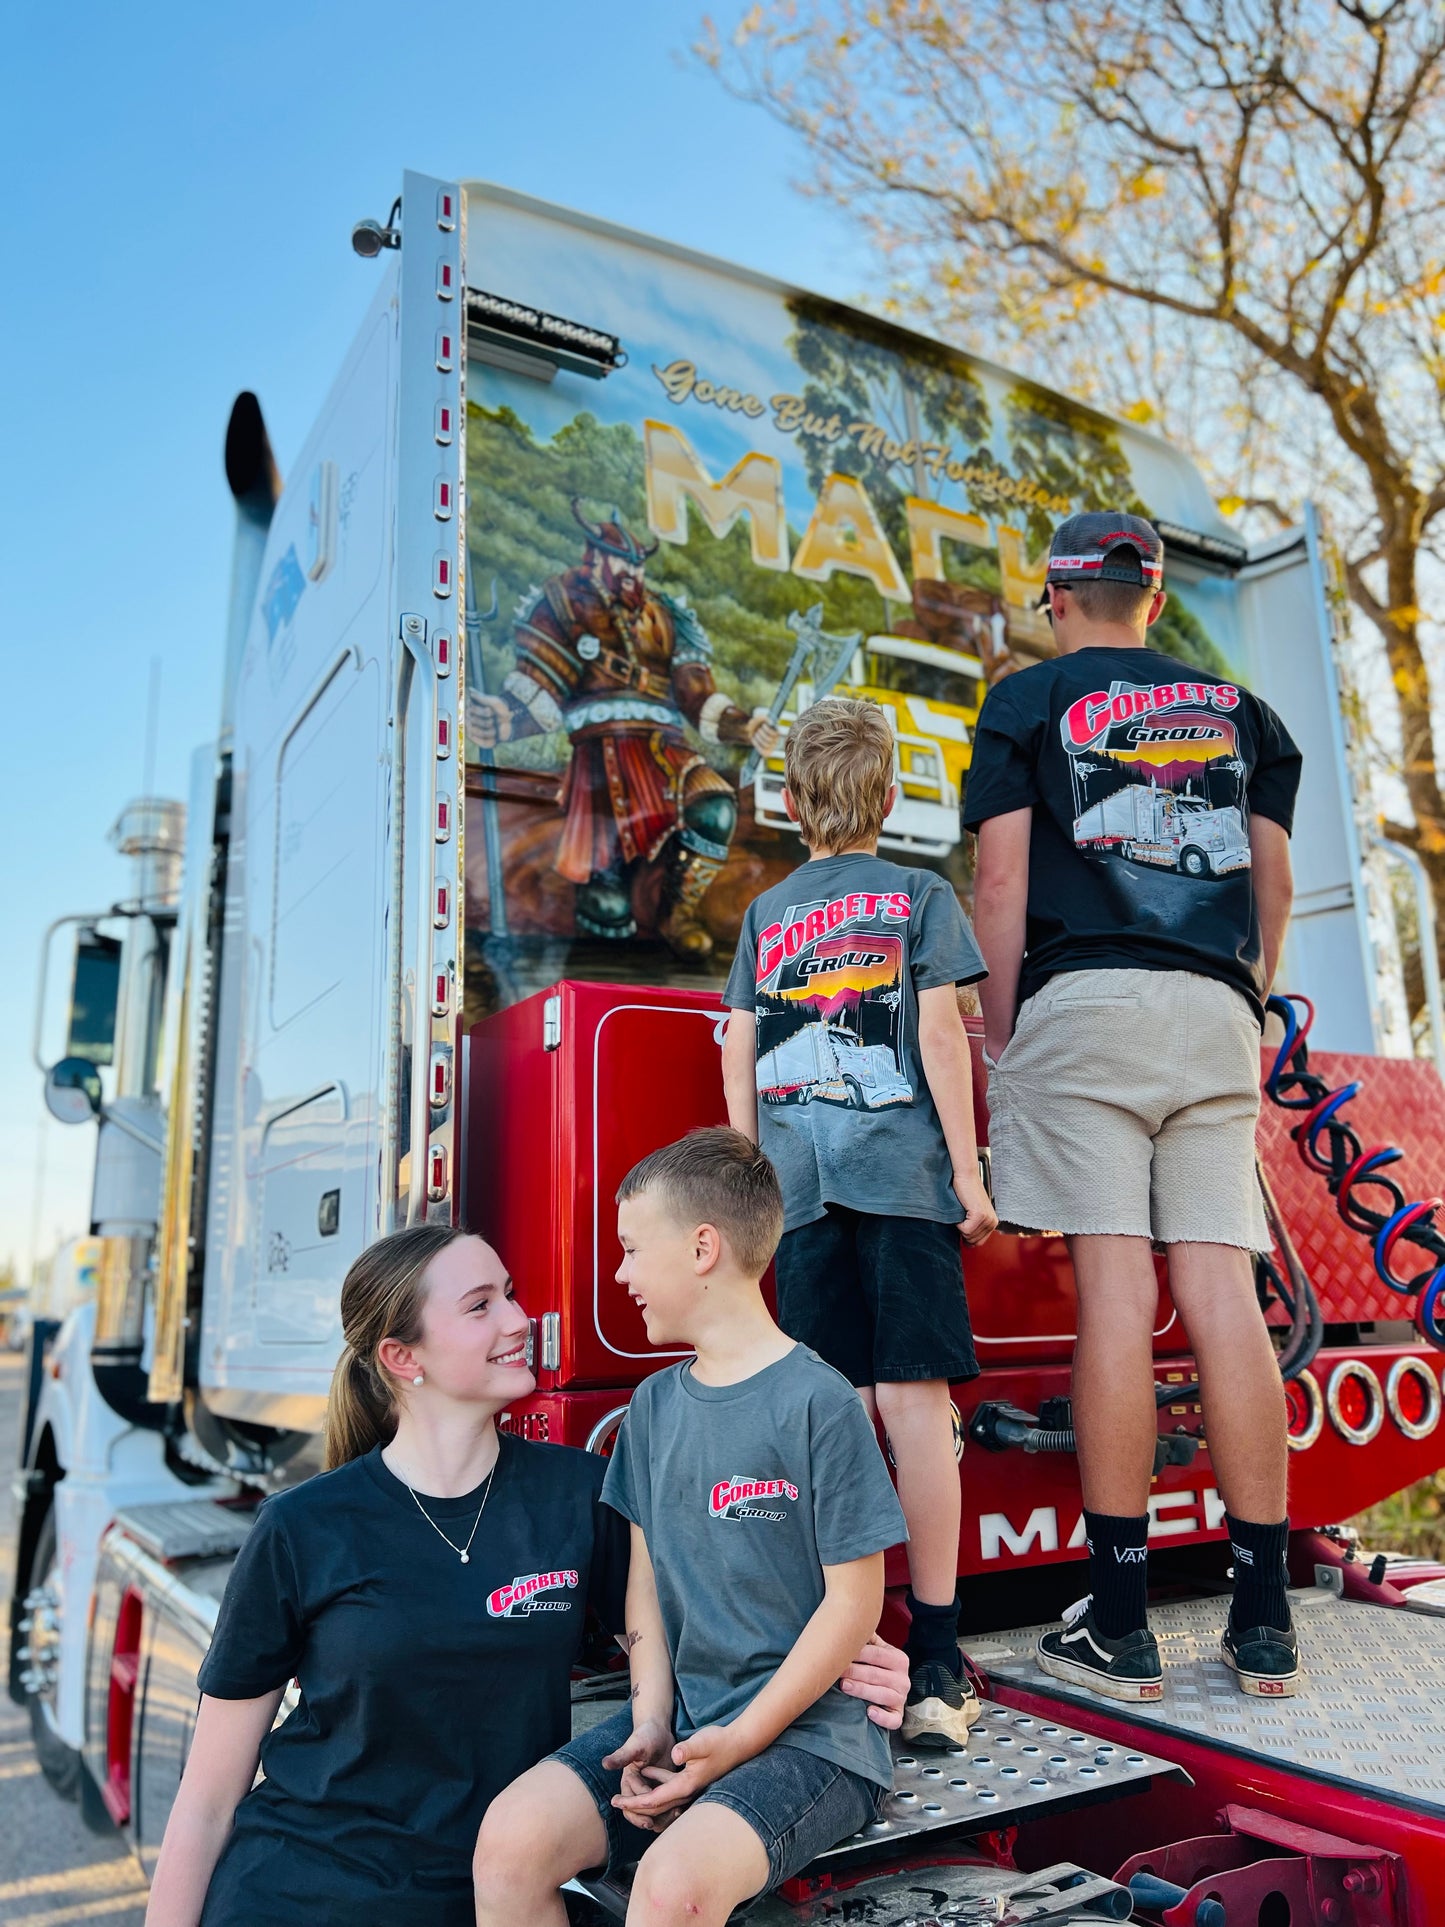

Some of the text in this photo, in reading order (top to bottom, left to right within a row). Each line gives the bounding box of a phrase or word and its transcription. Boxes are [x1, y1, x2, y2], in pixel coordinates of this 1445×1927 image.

[652, 360, 1072, 515] Gone But Not Forgotten
[567, 700, 674, 730] VOLVO
[1061, 682, 1240, 752] CORBET'S
[1127, 726, 1224, 742] GROUP
[755, 893, 911, 988] CORBET'S
[797, 950, 888, 977] GROUP
[709, 1479, 799, 1514] CORBET'S
[736, 1506, 787, 1521] GROUP
[979, 1487, 1227, 1561] MC
[1113, 1545, 1148, 1564] VAN
[487, 1570, 579, 1616] CORBET'S
[521, 1600, 572, 1612] GROUP
